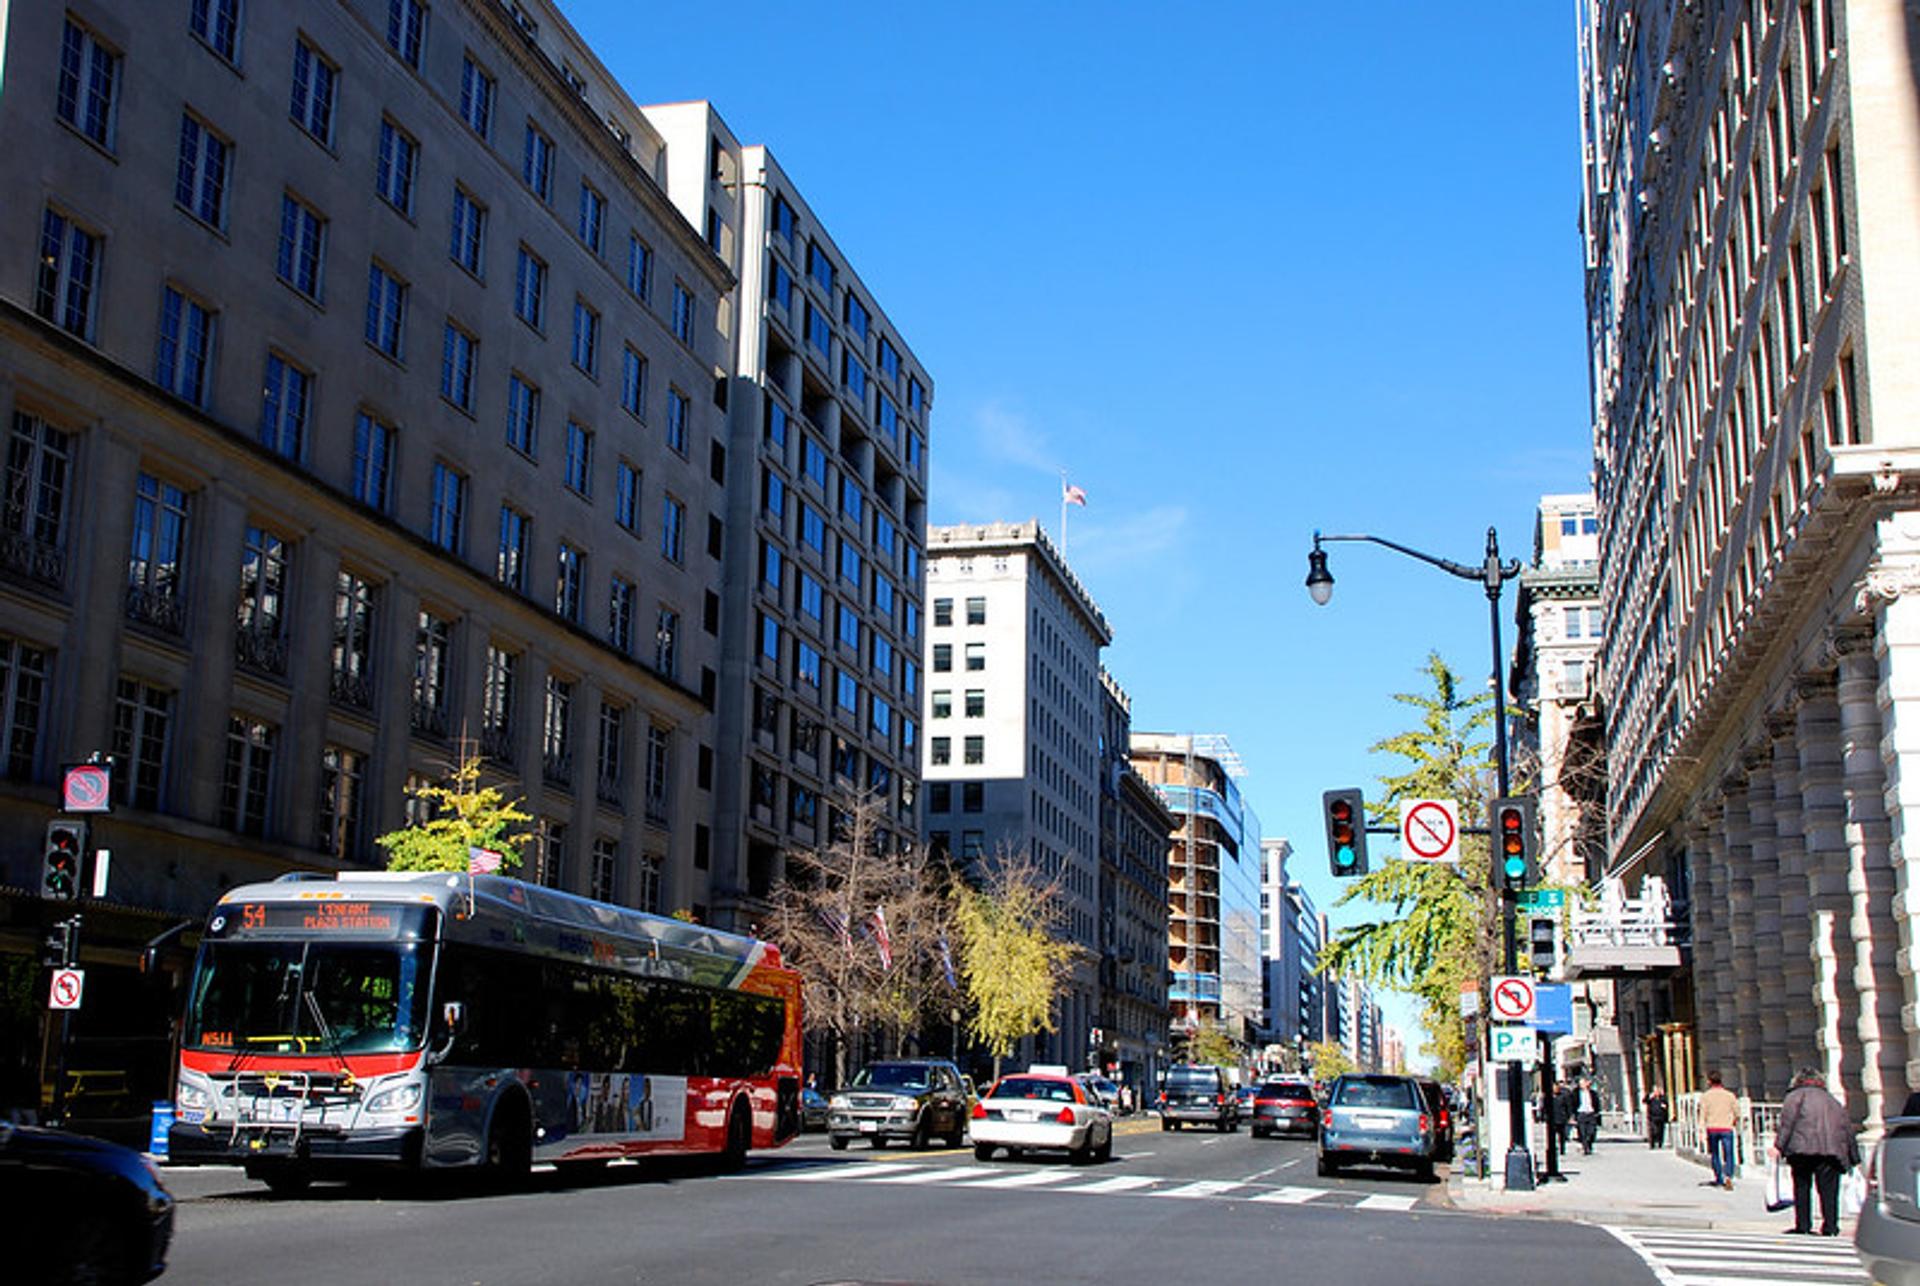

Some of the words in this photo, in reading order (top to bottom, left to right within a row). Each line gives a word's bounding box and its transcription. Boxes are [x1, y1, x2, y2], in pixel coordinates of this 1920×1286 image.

[242, 904, 266, 928] 54
[343, 916, 390, 928] STATION
[1497, 1032, 1513, 1054] P
